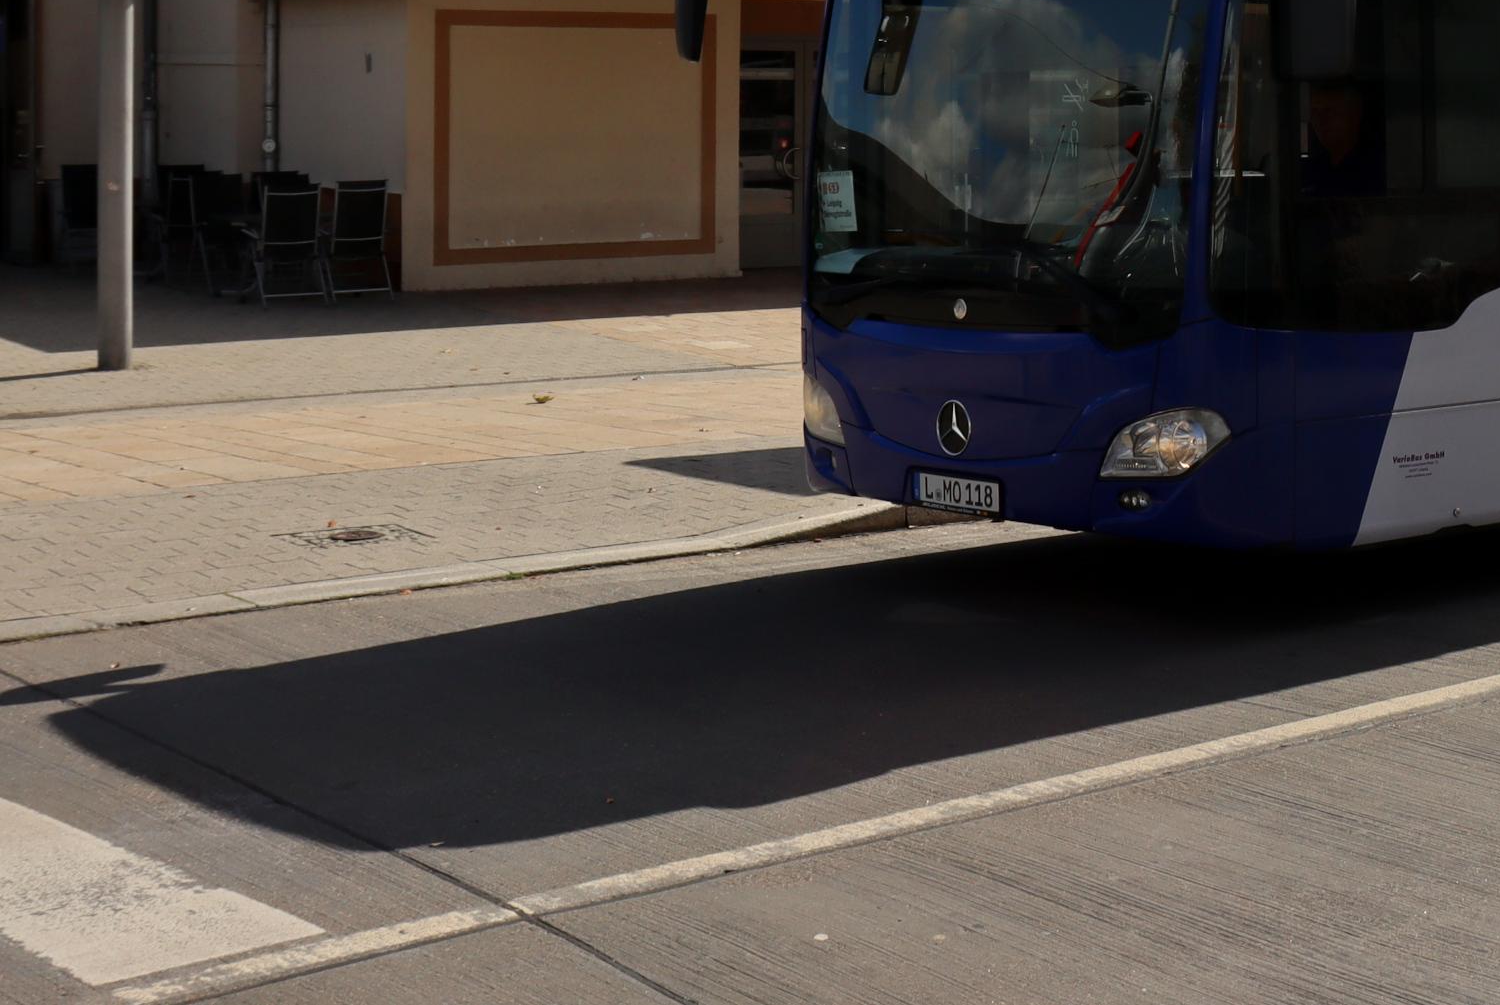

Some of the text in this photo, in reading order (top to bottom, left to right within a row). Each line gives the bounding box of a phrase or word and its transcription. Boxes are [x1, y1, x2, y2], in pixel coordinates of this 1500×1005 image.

[1424, 451, 1444, 460] GmbH
[943, 479, 961, 504] MO
[965, 483, 993, 508] 118
